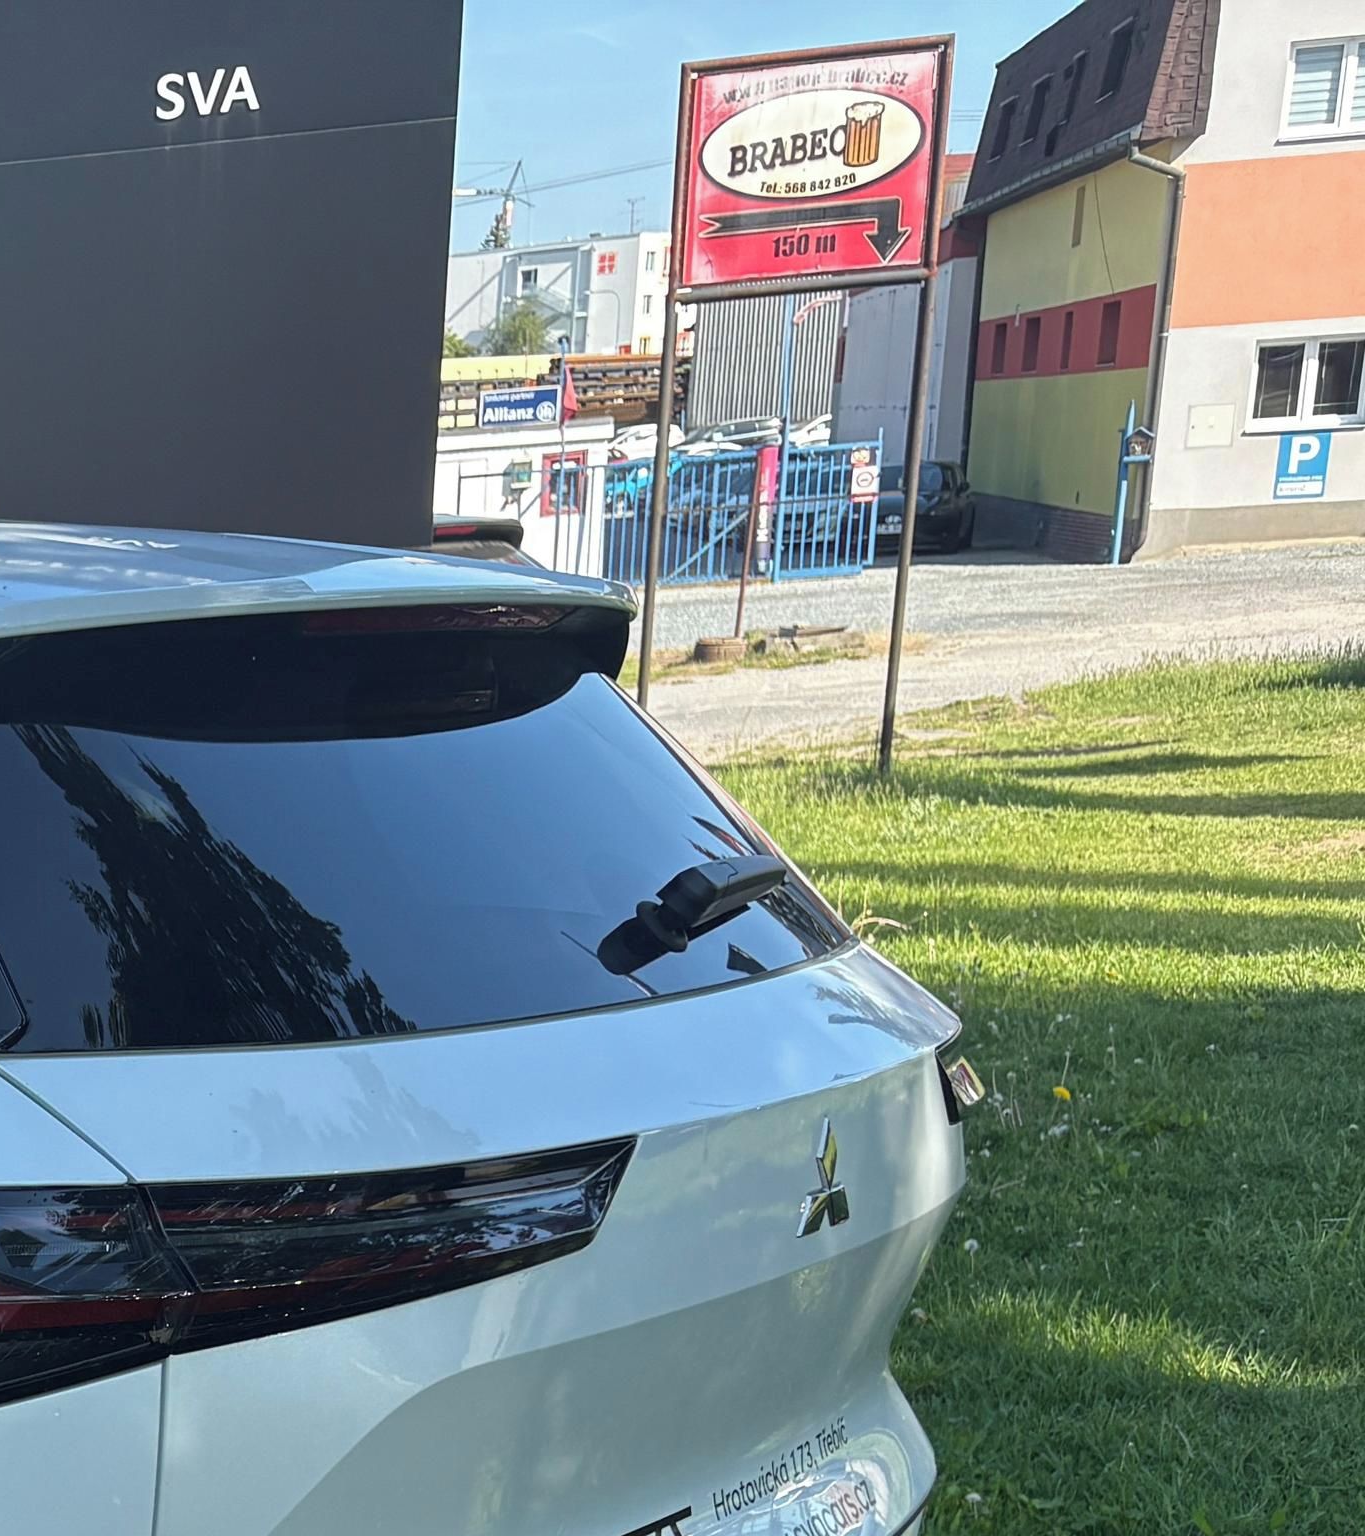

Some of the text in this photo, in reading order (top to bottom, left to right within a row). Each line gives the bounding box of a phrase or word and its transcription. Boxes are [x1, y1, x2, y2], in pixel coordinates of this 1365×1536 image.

[156, 66, 260, 121] SVA
[728, 124, 847, 177] BRABEC
[785, 181, 806, 194] 568
[809, 179, 832, 193] 842
[835, 173, 857, 189] 820
[772, 233, 836, 258] 150 m
[483, 407, 535, 423] Allianz
[1287, 435, 1321, 474] P
[712, 1416, 849, 1521] Hrotovická 173, Třebíč
